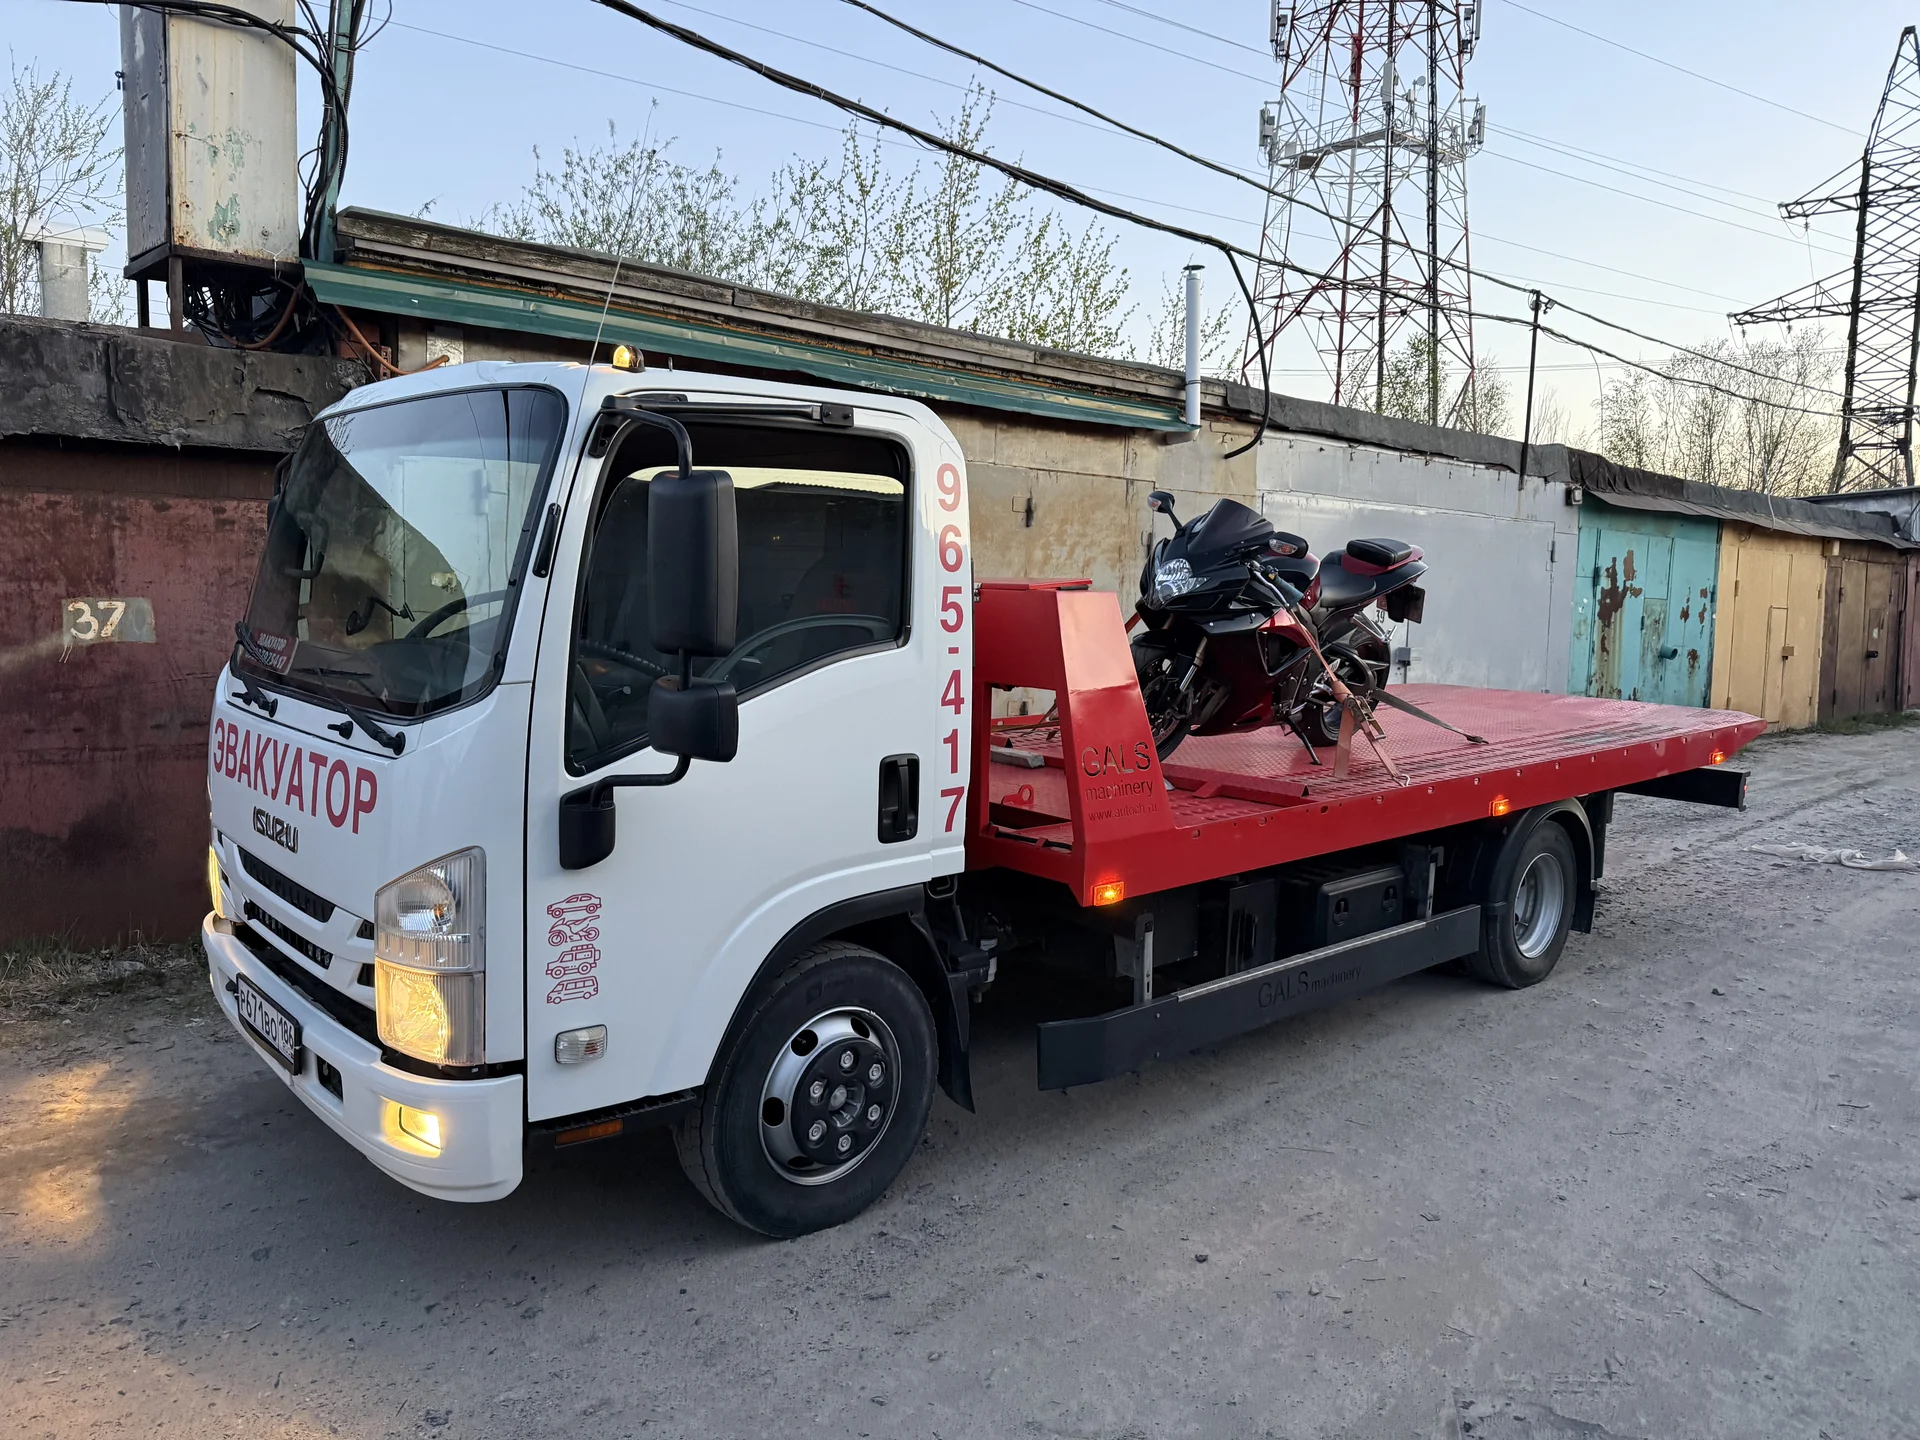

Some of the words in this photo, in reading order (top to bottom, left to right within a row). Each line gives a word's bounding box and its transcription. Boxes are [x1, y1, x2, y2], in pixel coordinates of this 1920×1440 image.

[68, 601, 126, 640] 37
[937, 463, 964, 832] 965-417
[213, 717, 378, 835] ЭВАКУАТОР
[1082, 741, 1151, 777] GALS
[1085, 780, 1153, 802] machinery
[252, 805, 299, 853] ISUZU
[1258, 970, 1309, 1008] GALS
[1311, 965, 1361, 992] machinery
